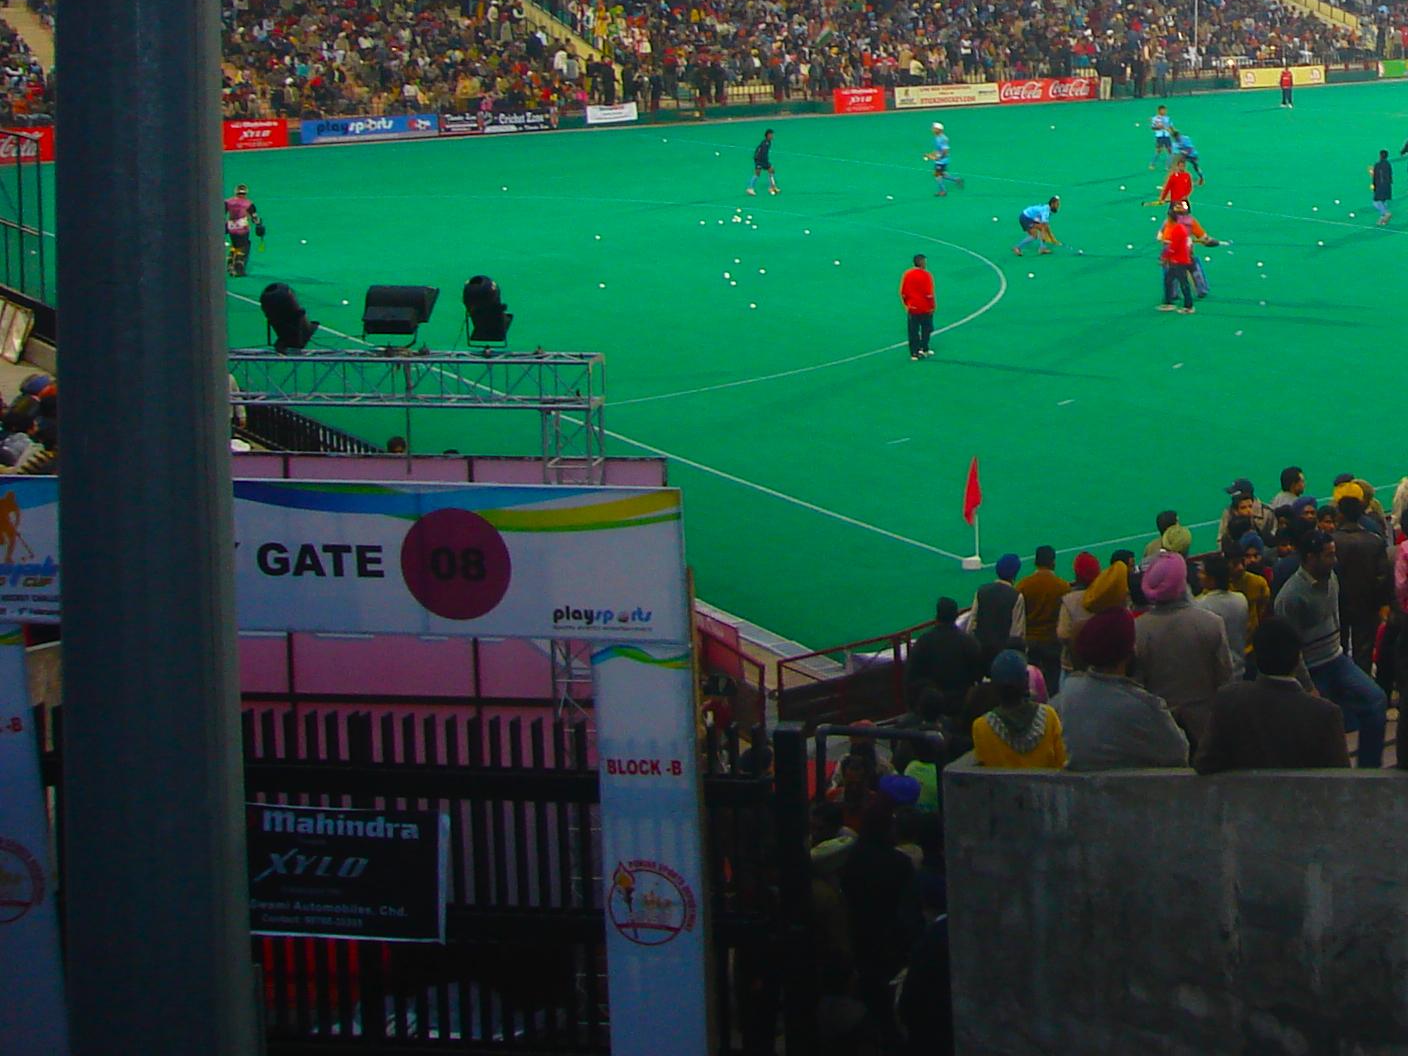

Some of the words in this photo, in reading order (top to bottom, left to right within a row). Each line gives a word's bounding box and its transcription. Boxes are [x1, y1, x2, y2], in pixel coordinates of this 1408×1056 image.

[1001, 81, 1042, 100] Coca-Cola
[1049, 79, 1090, 98] Coca-Cola
[316, 117, 394, 136] playsports
[256, 542, 385, 578] GATE
[431, 547, 487, 581] 08
[553, 605, 652, 625] playsports
[607, 759, 662, 776] BLOCK
[262, 809, 421, 840] Mahindra
[254, 847, 369, 881] XYLO
